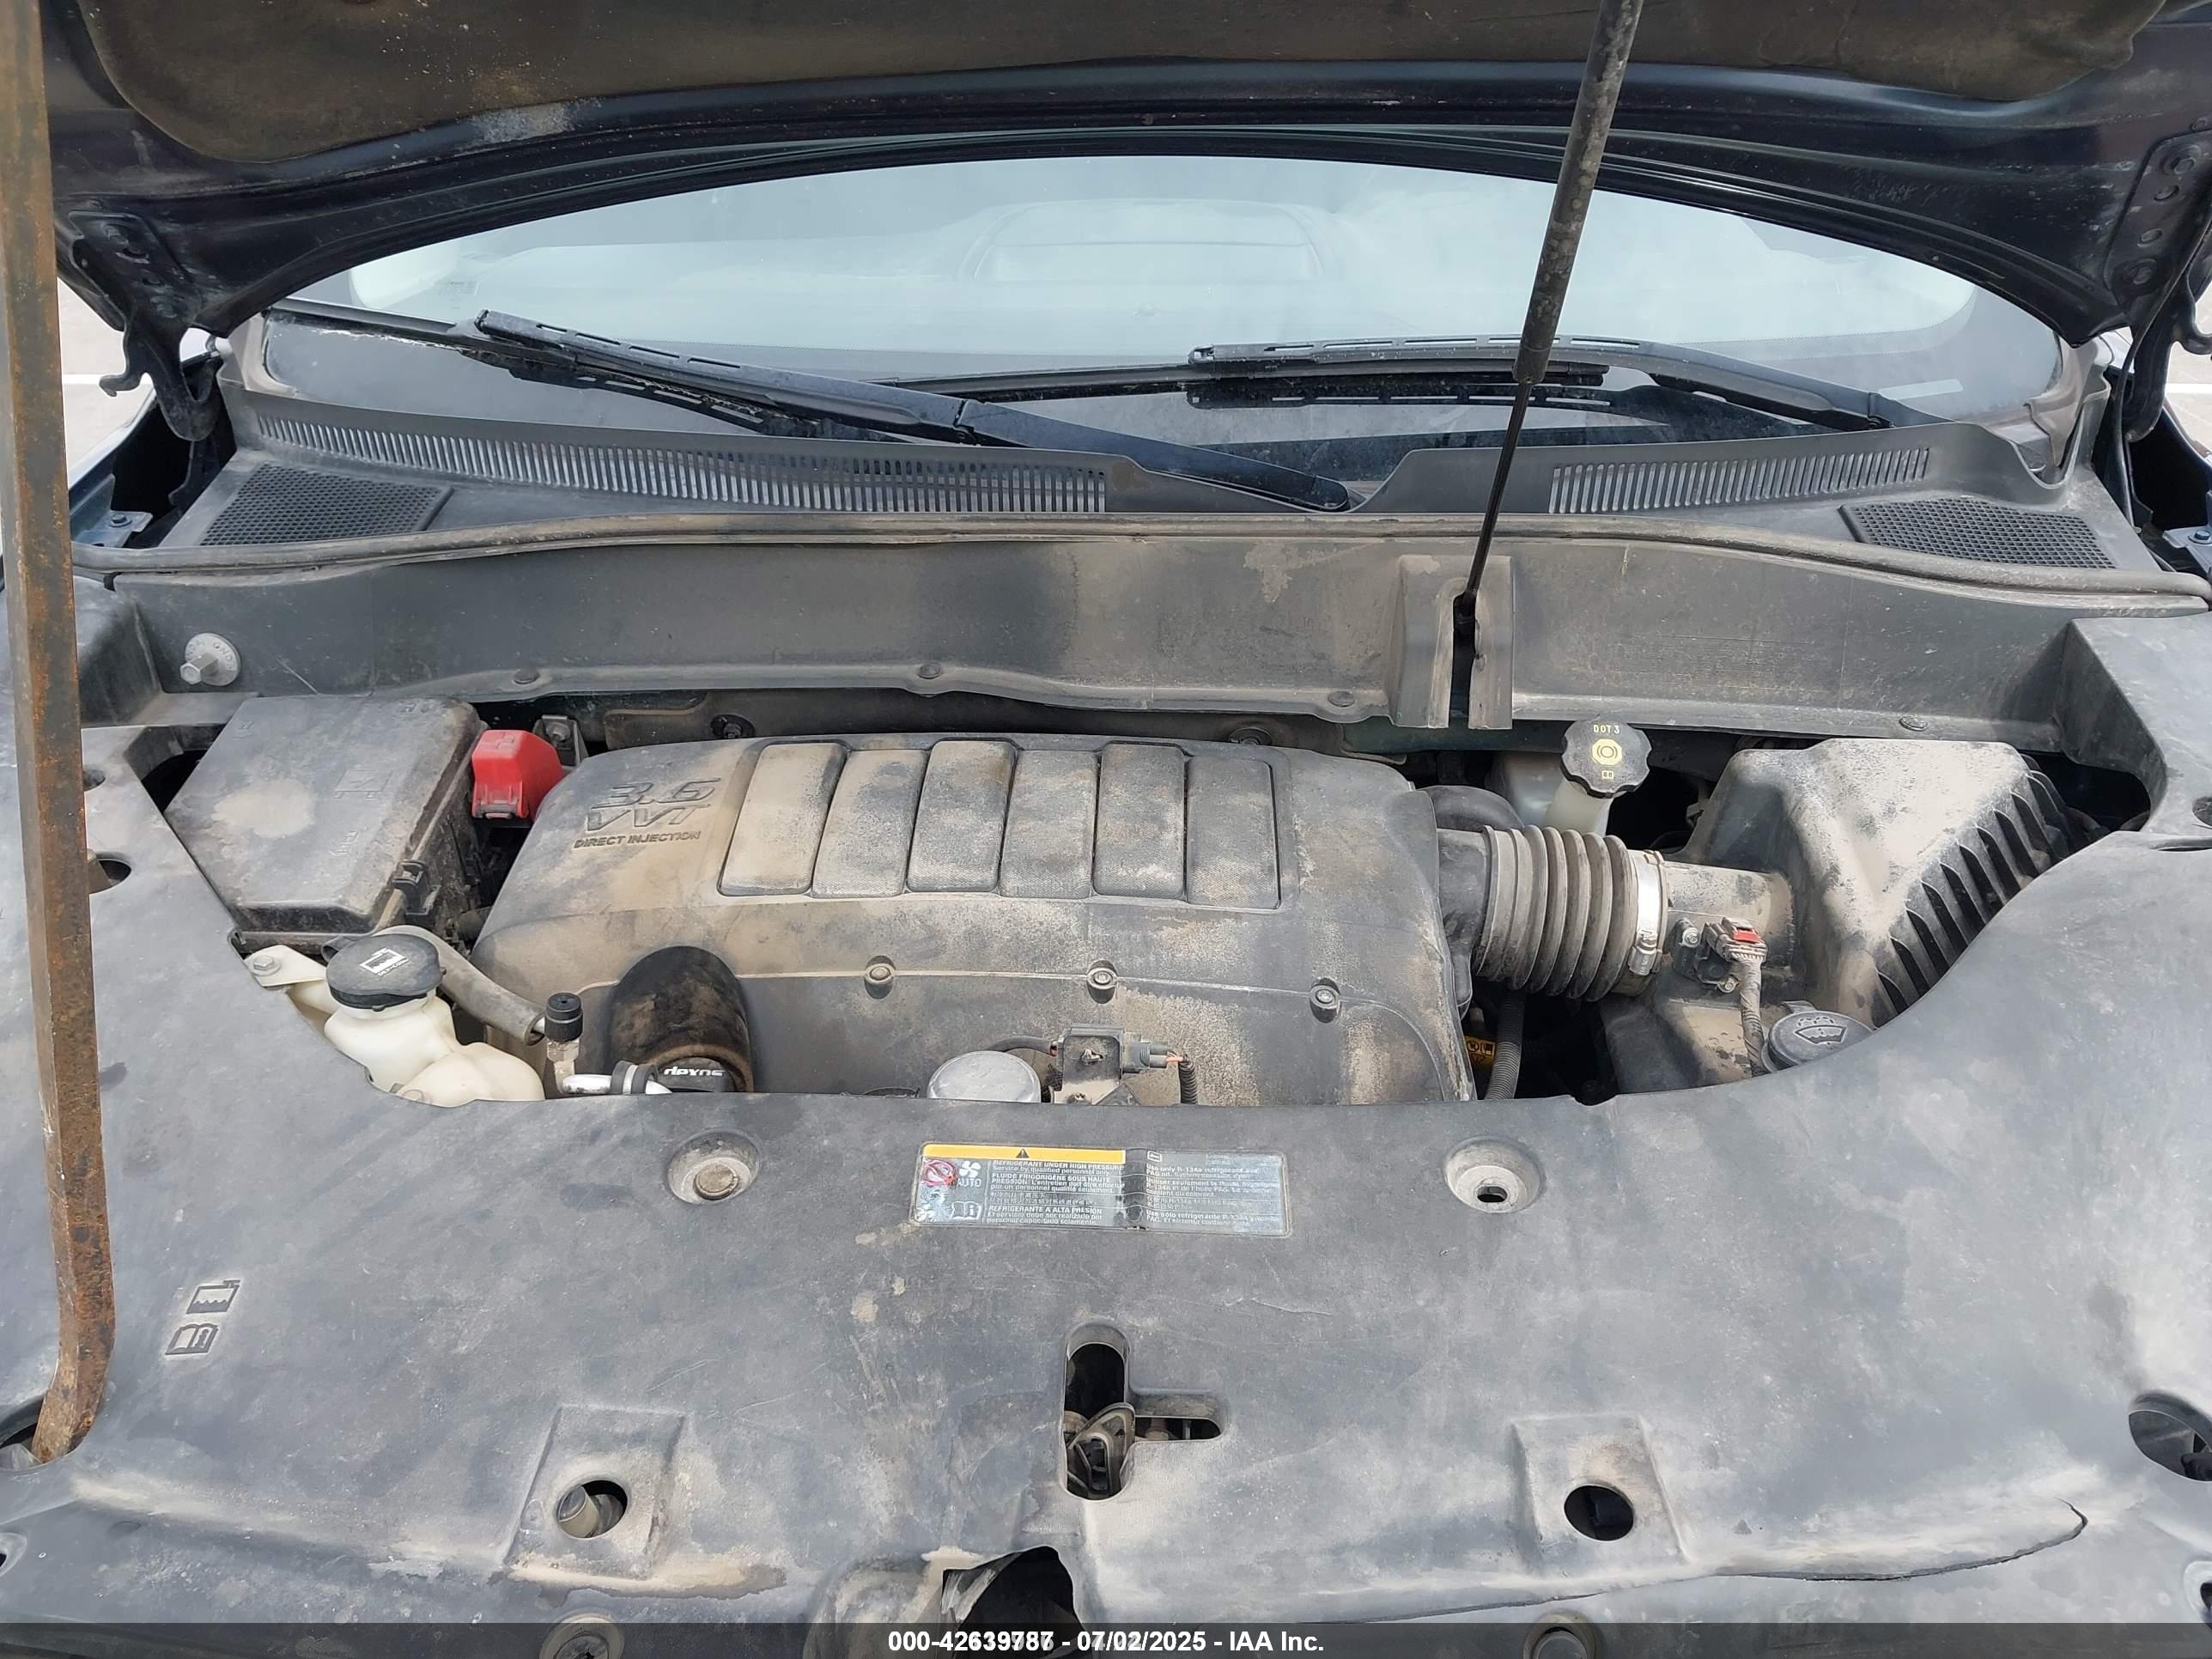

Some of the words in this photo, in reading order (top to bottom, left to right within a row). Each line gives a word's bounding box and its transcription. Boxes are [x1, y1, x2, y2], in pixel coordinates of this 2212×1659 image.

[1593, 724, 1611, 733] DOT
[1613, 725, 1620, 734] 3
[591, 777, 721, 809] 3.6
[586, 803, 711, 832] VVT
[573, 836, 626, 849] DIRECT
[627, 830, 702, 845] INJECTION
[1030, 1166, 1060, 1175] qualified
[957, 1178, 982, 1188] AUTO
